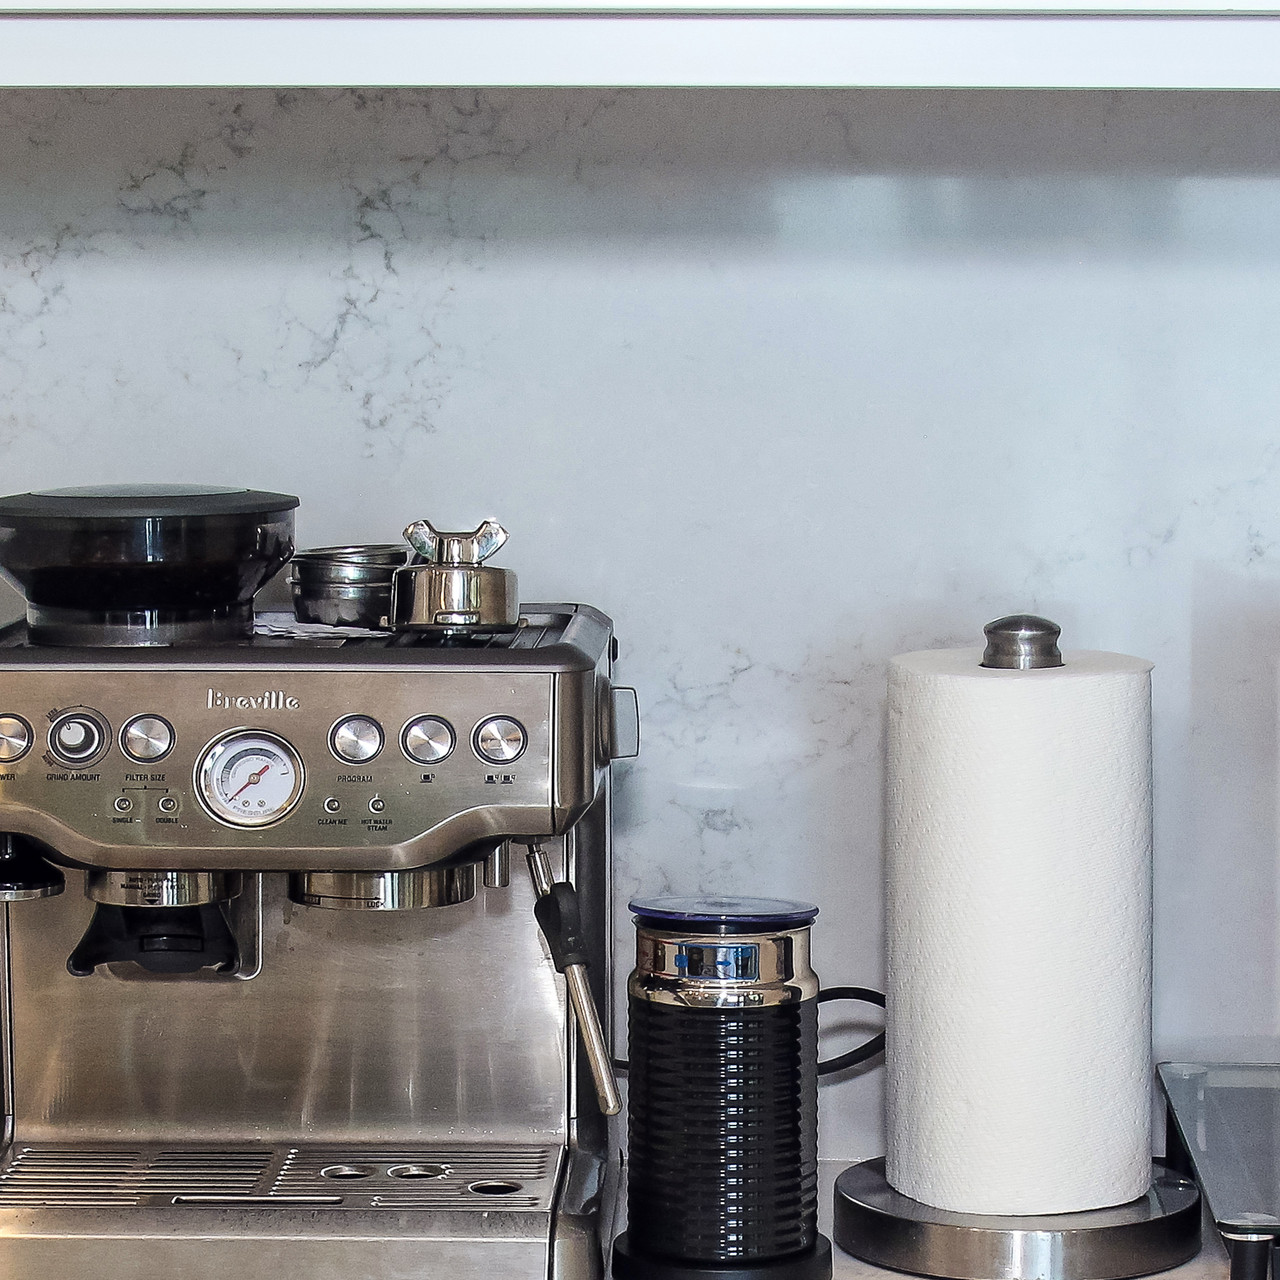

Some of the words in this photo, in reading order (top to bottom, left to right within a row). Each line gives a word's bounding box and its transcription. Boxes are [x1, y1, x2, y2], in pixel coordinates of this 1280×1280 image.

[206, 687, 300, 710] Breville
[46, 773, 68, 781] GRIND
[70, 773, 101, 781] AMOUNT
[125, 773, 149, 782] FILTER
[150, 774, 166, 782] SIZE
[337, 775, 373, 783] PROGRAM
